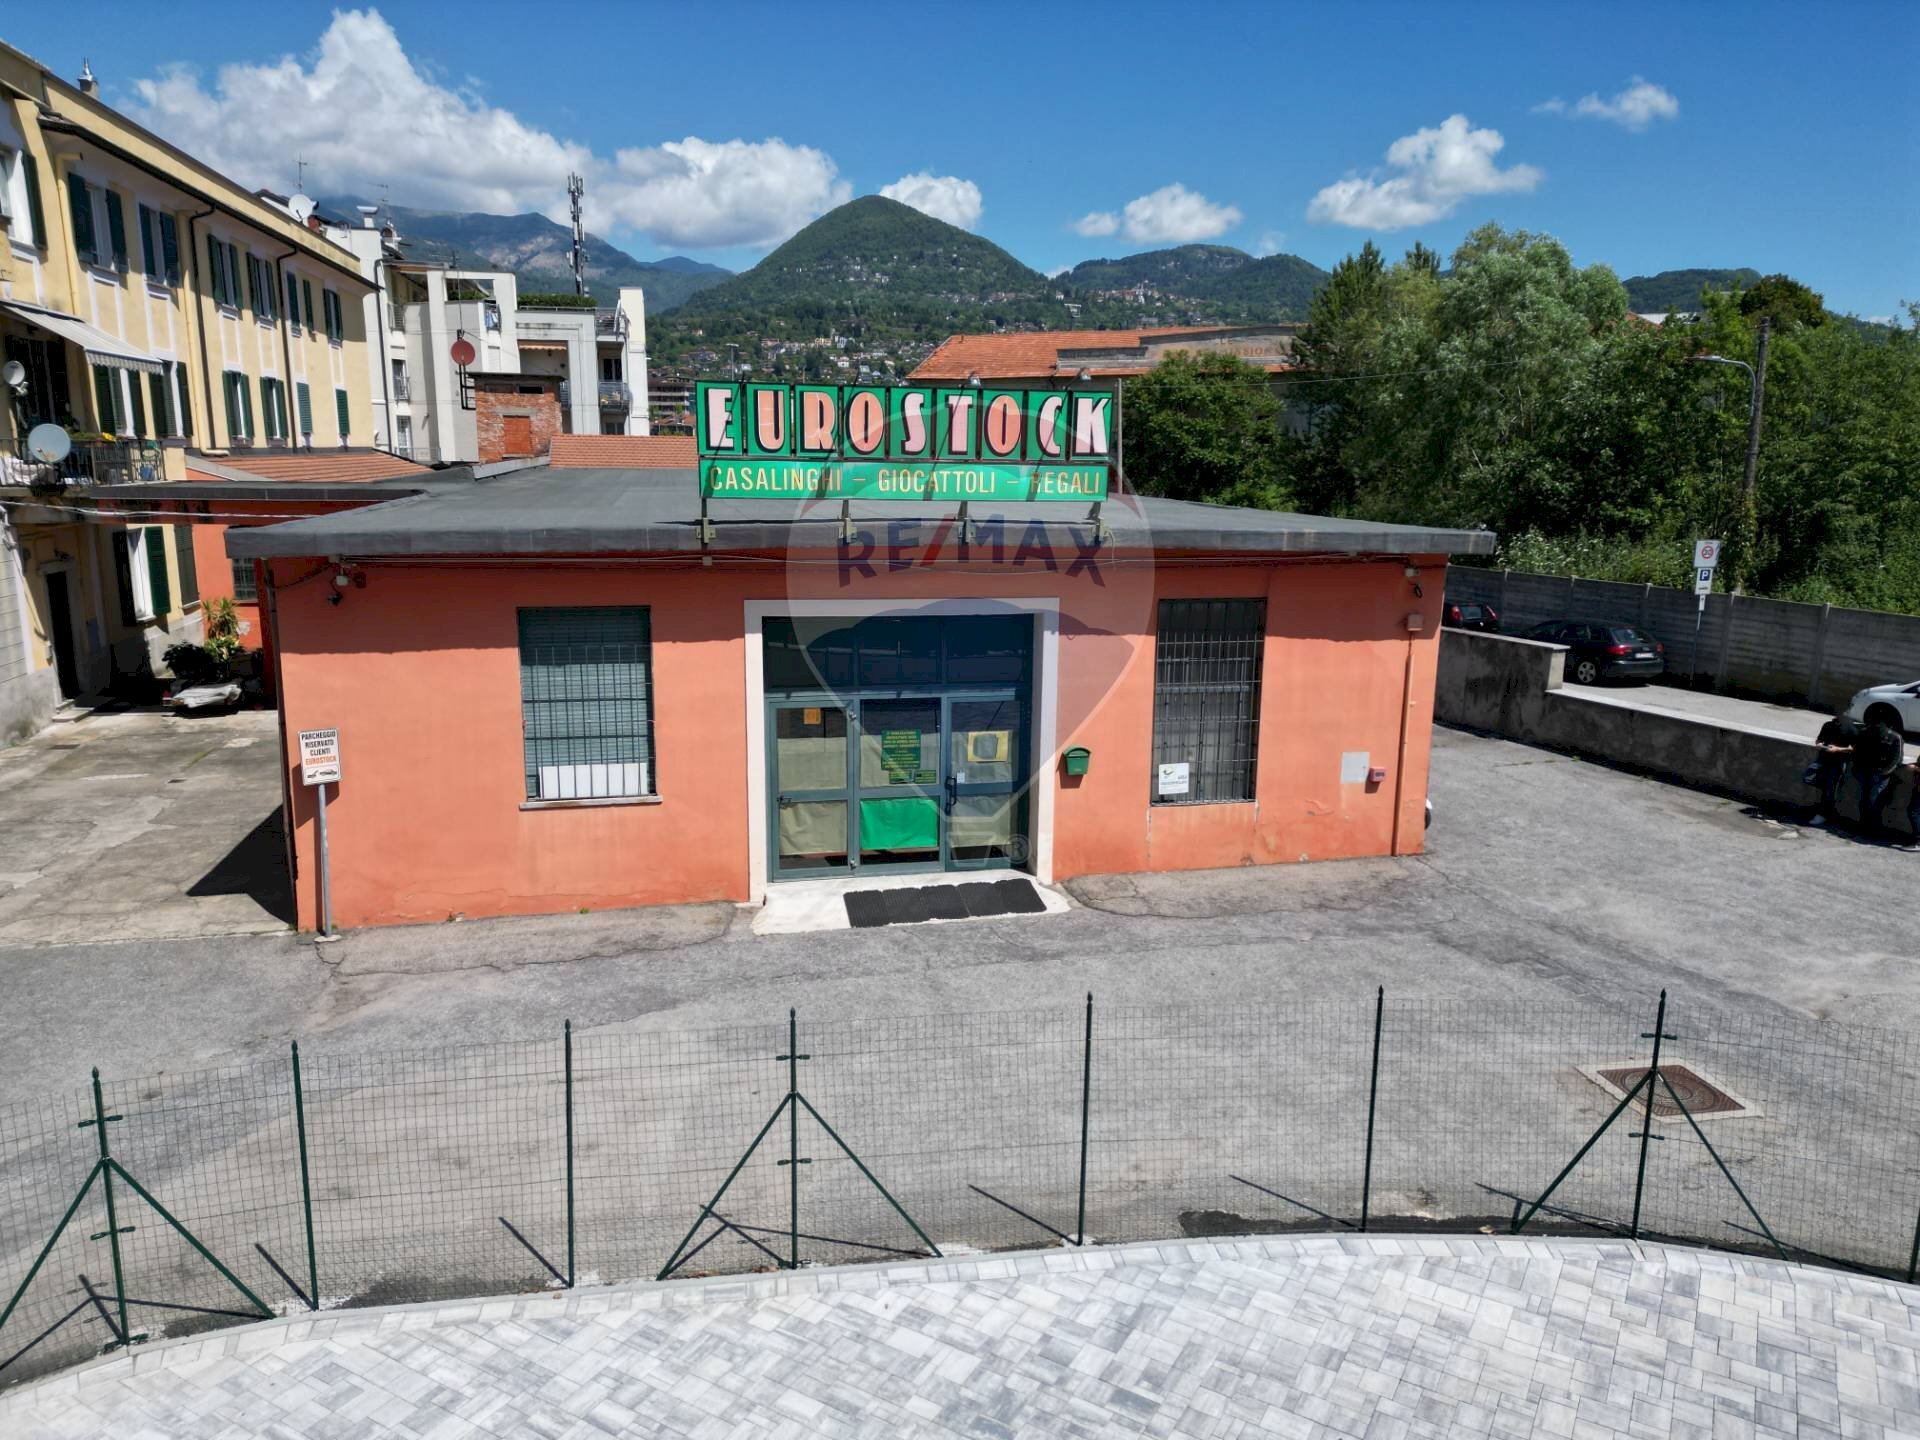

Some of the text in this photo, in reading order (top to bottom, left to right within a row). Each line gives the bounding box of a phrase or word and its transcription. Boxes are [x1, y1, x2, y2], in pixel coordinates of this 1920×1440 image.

[706, 388, 1109, 457] EUROSTOCK
[711, 467, 841, 491] CASALINGHI
[878, 469, 995, 494] GIOCATTOLI
[1031, 472, 1099, 494] REGALI
[1701, 570, 1709, 580] P
[301, 731, 335, 740] PARCHEGGIO
[305, 739, 334, 748] RISERVATO
[310, 748, 331, 756] CLIENTI
